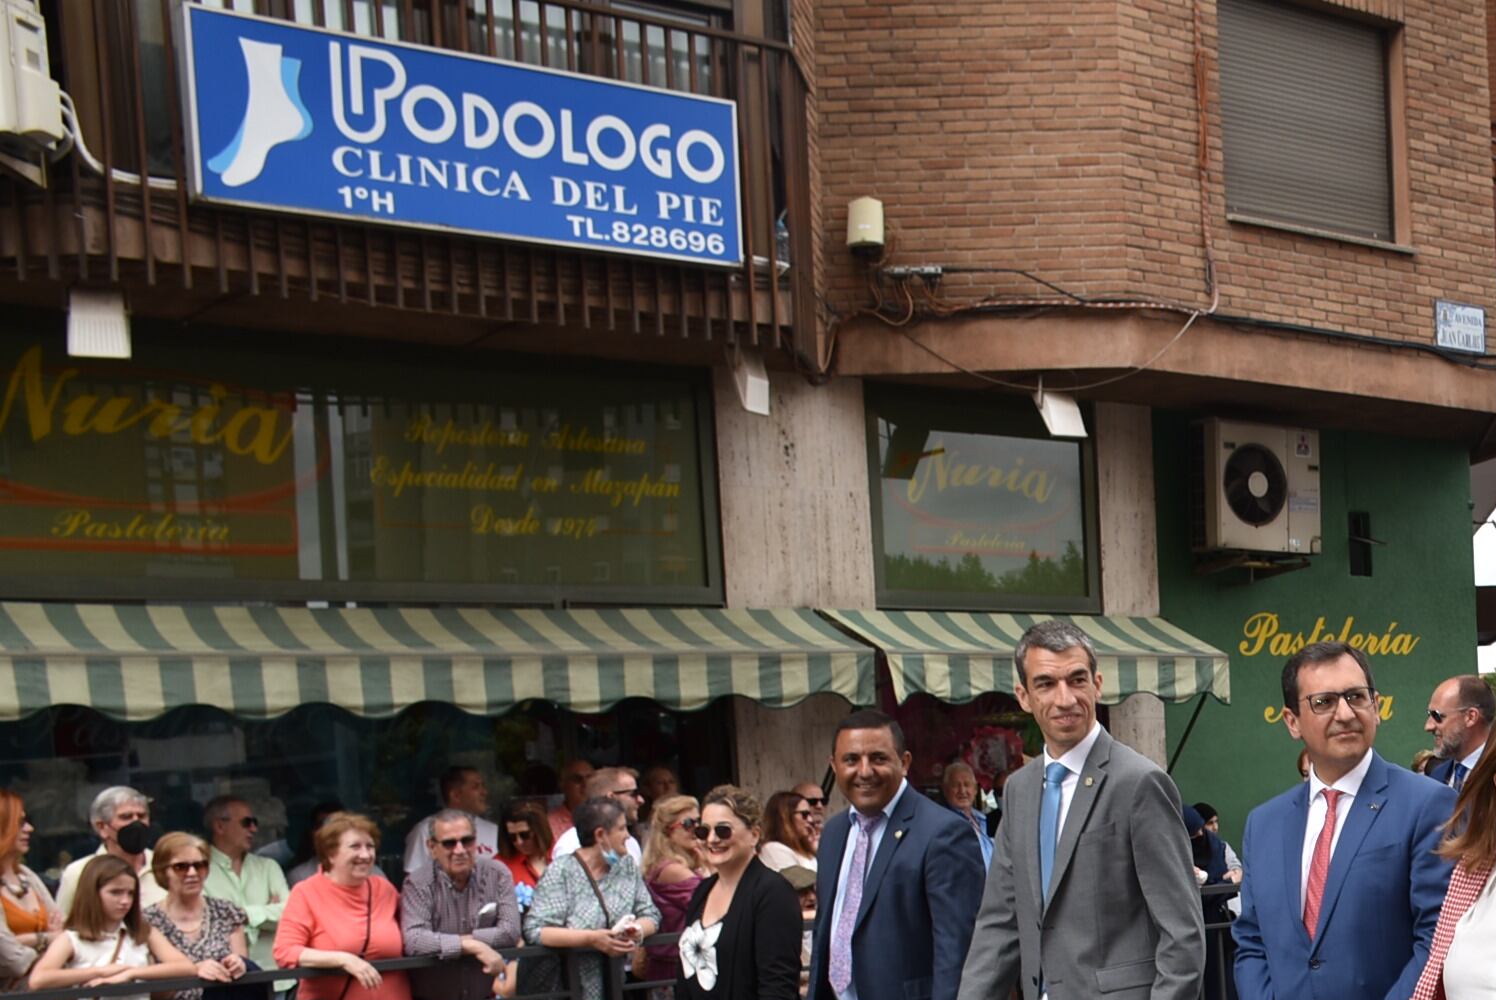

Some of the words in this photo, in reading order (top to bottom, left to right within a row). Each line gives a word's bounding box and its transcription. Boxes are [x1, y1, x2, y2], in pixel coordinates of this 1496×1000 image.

[329, 41, 725, 184] PODOLOGO
[331, 145, 531, 201] CLINICA
[550, 176, 638, 216] DEL
[656, 191, 725, 227] PIE
[566, 215, 725, 256] TL.828696
[0, 344, 295, 466] Nuria
[542, 422, 646, 454] Artesana
[370, 456, 524, 496] Especialidad
[531, 477, 559, 493] en
[570, 468, 681, 507] Mazapán
[908, 442, 1056, 504] Nuria
[470, 503, 541, 535] Desde
